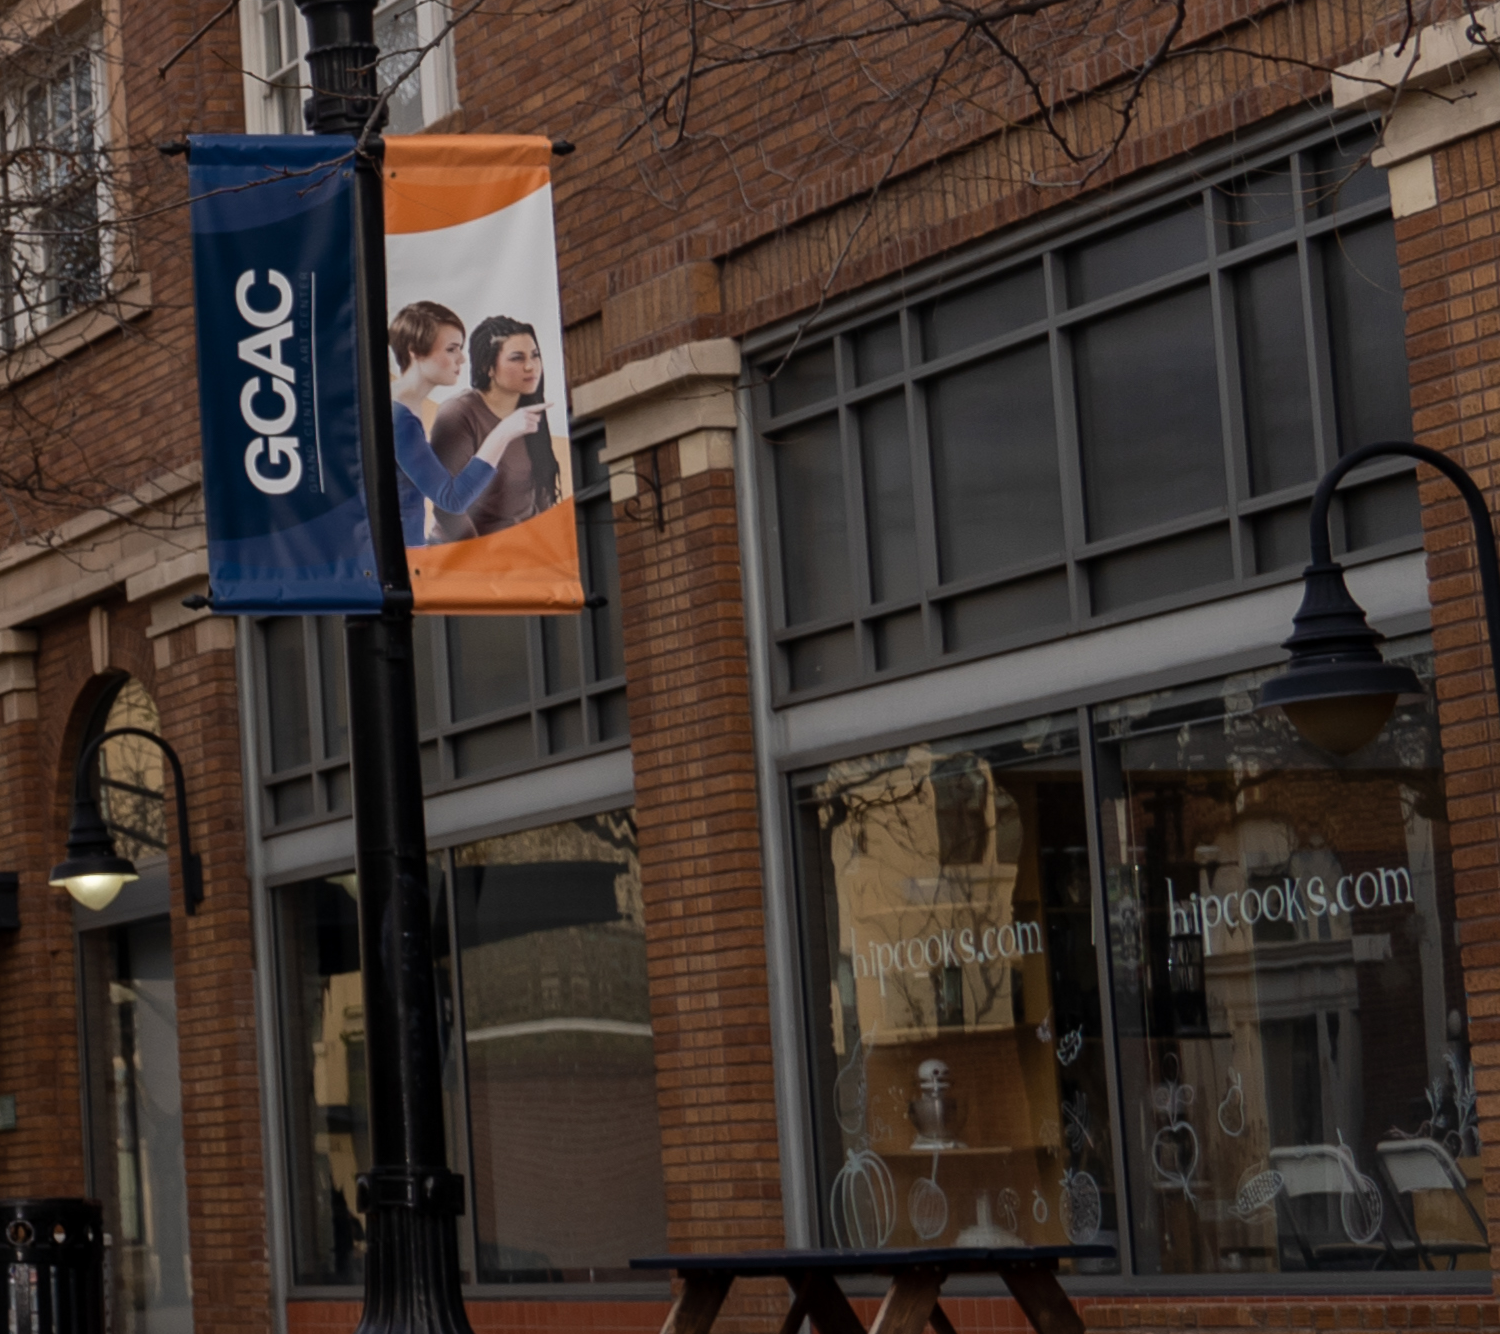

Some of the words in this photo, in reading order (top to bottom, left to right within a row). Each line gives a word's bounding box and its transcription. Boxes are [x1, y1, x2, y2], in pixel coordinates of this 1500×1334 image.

[299, 271, 309, 329] CENTER
[235, 269, 301, 495] GCAC
[300, 338, 310, 364] ART
[301, 371, 312, 437] CENTRAL
[1165, 864, 1414, 958] hipcooks.com
[851, 919, 1043, 997] hipcooks.com
